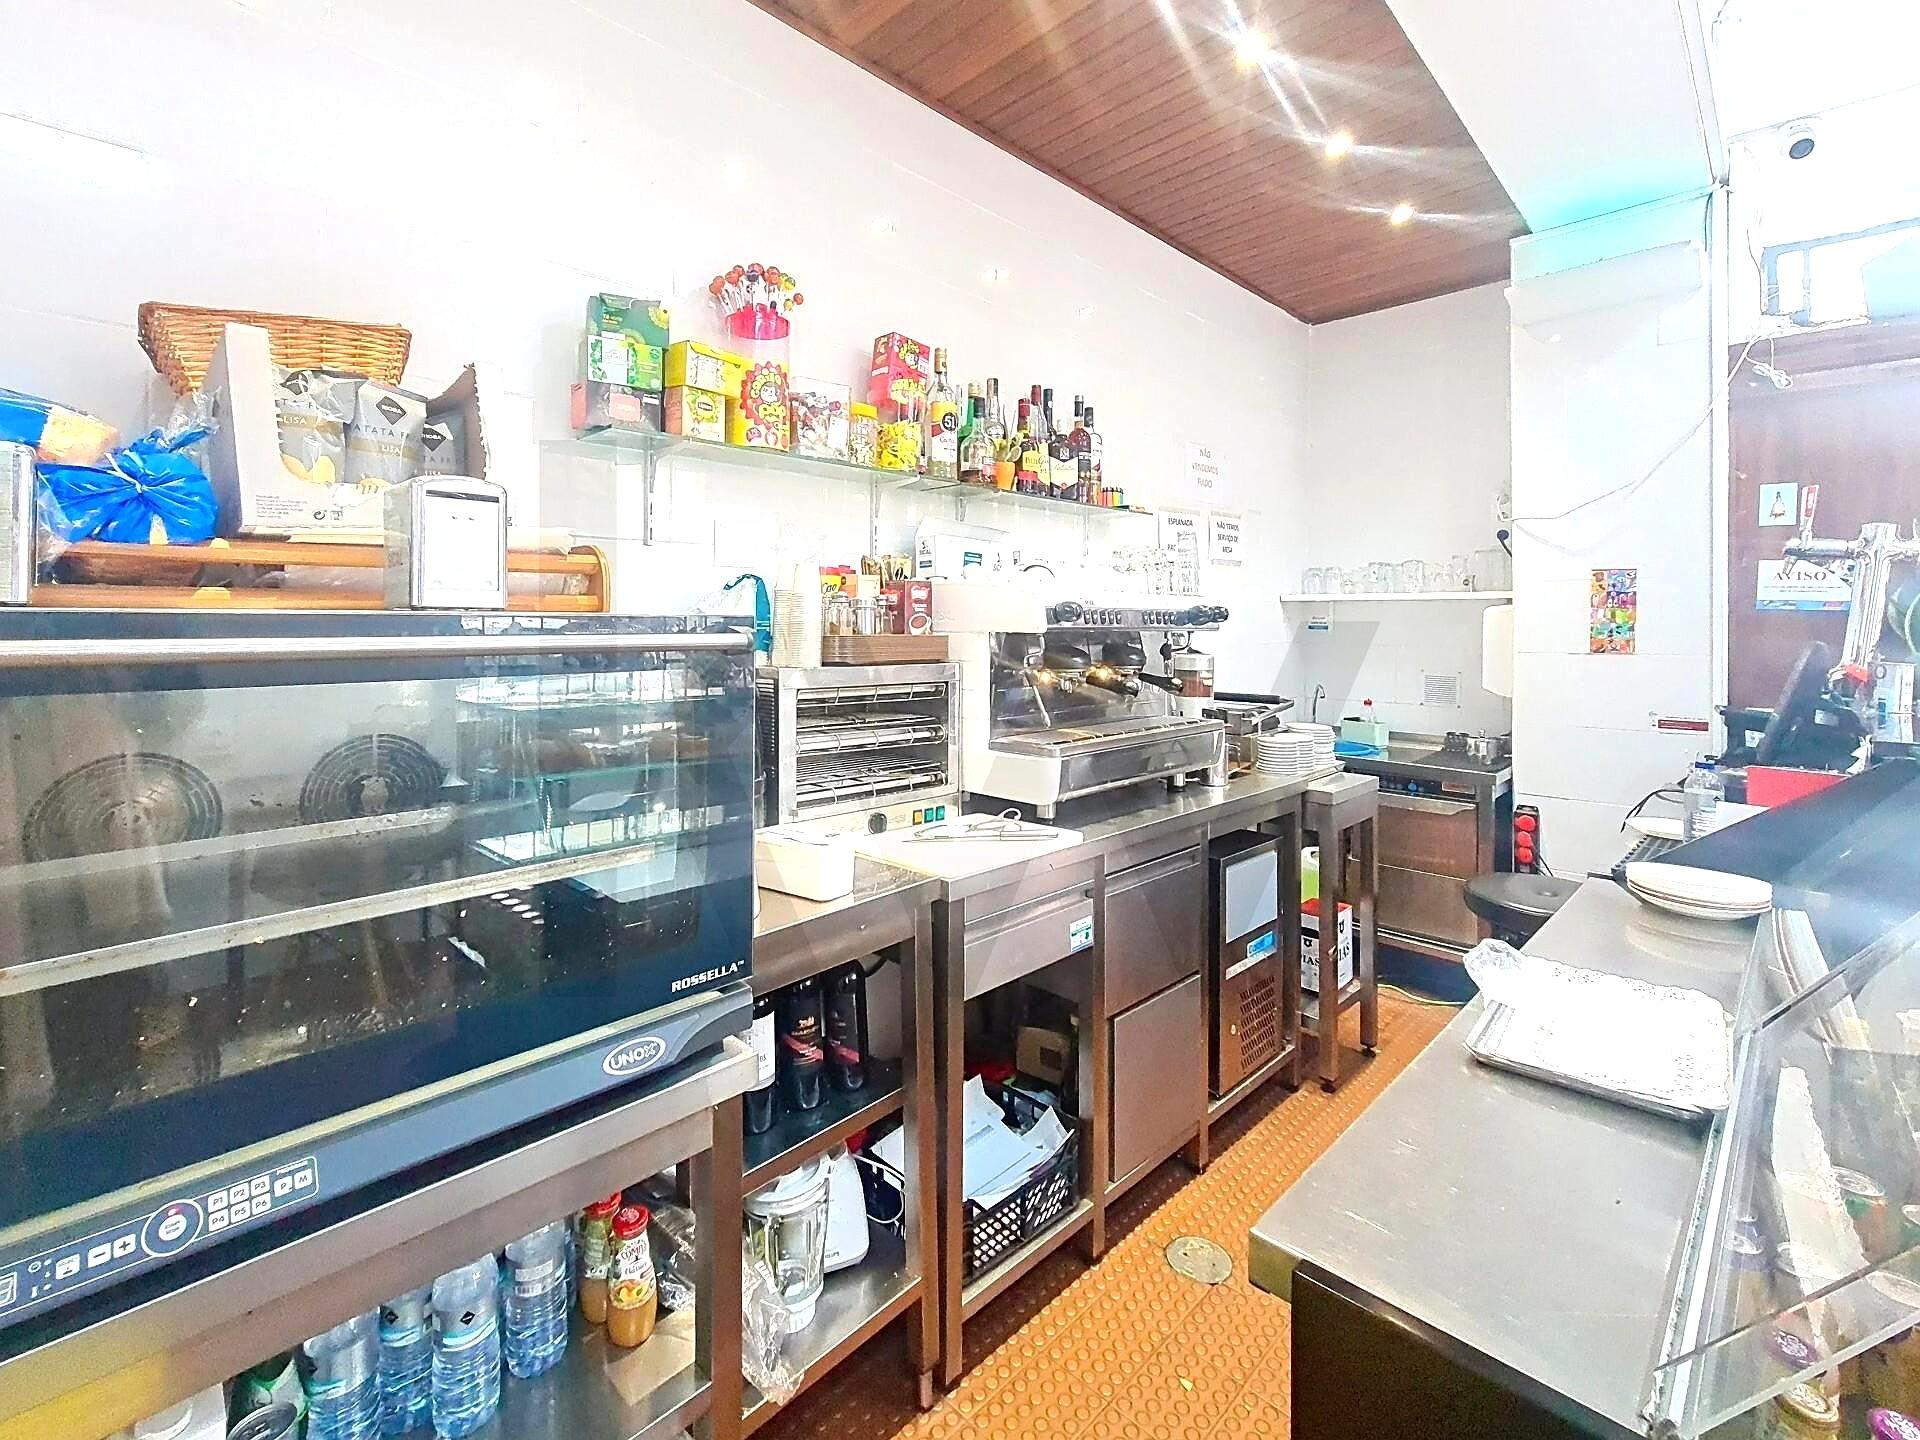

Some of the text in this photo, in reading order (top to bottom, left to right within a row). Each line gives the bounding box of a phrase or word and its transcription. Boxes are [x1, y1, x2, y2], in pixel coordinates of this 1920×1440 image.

[283, 416, 307, 425] LISA
[943, 415, 956, 430] 51
[354, 423, 396, 437] ATATA
[382, 444, 401, 454] LISA
[1167, 517, 1194, 527] ESPLANADA
[1216, 520, 1240, 532] NÃO TEMOS
[1774, 571, 1827, 581] AVISO
[610, 1042, 657, 1069] UNOX
[254, 1181, 267, 1191] P3
[233, 1189, 246, 1199] P2
[212, 1197, 224, 1207] P1
[255, 1199, 268, 1210] P6
[234, 1206, 247, 1217] P5
